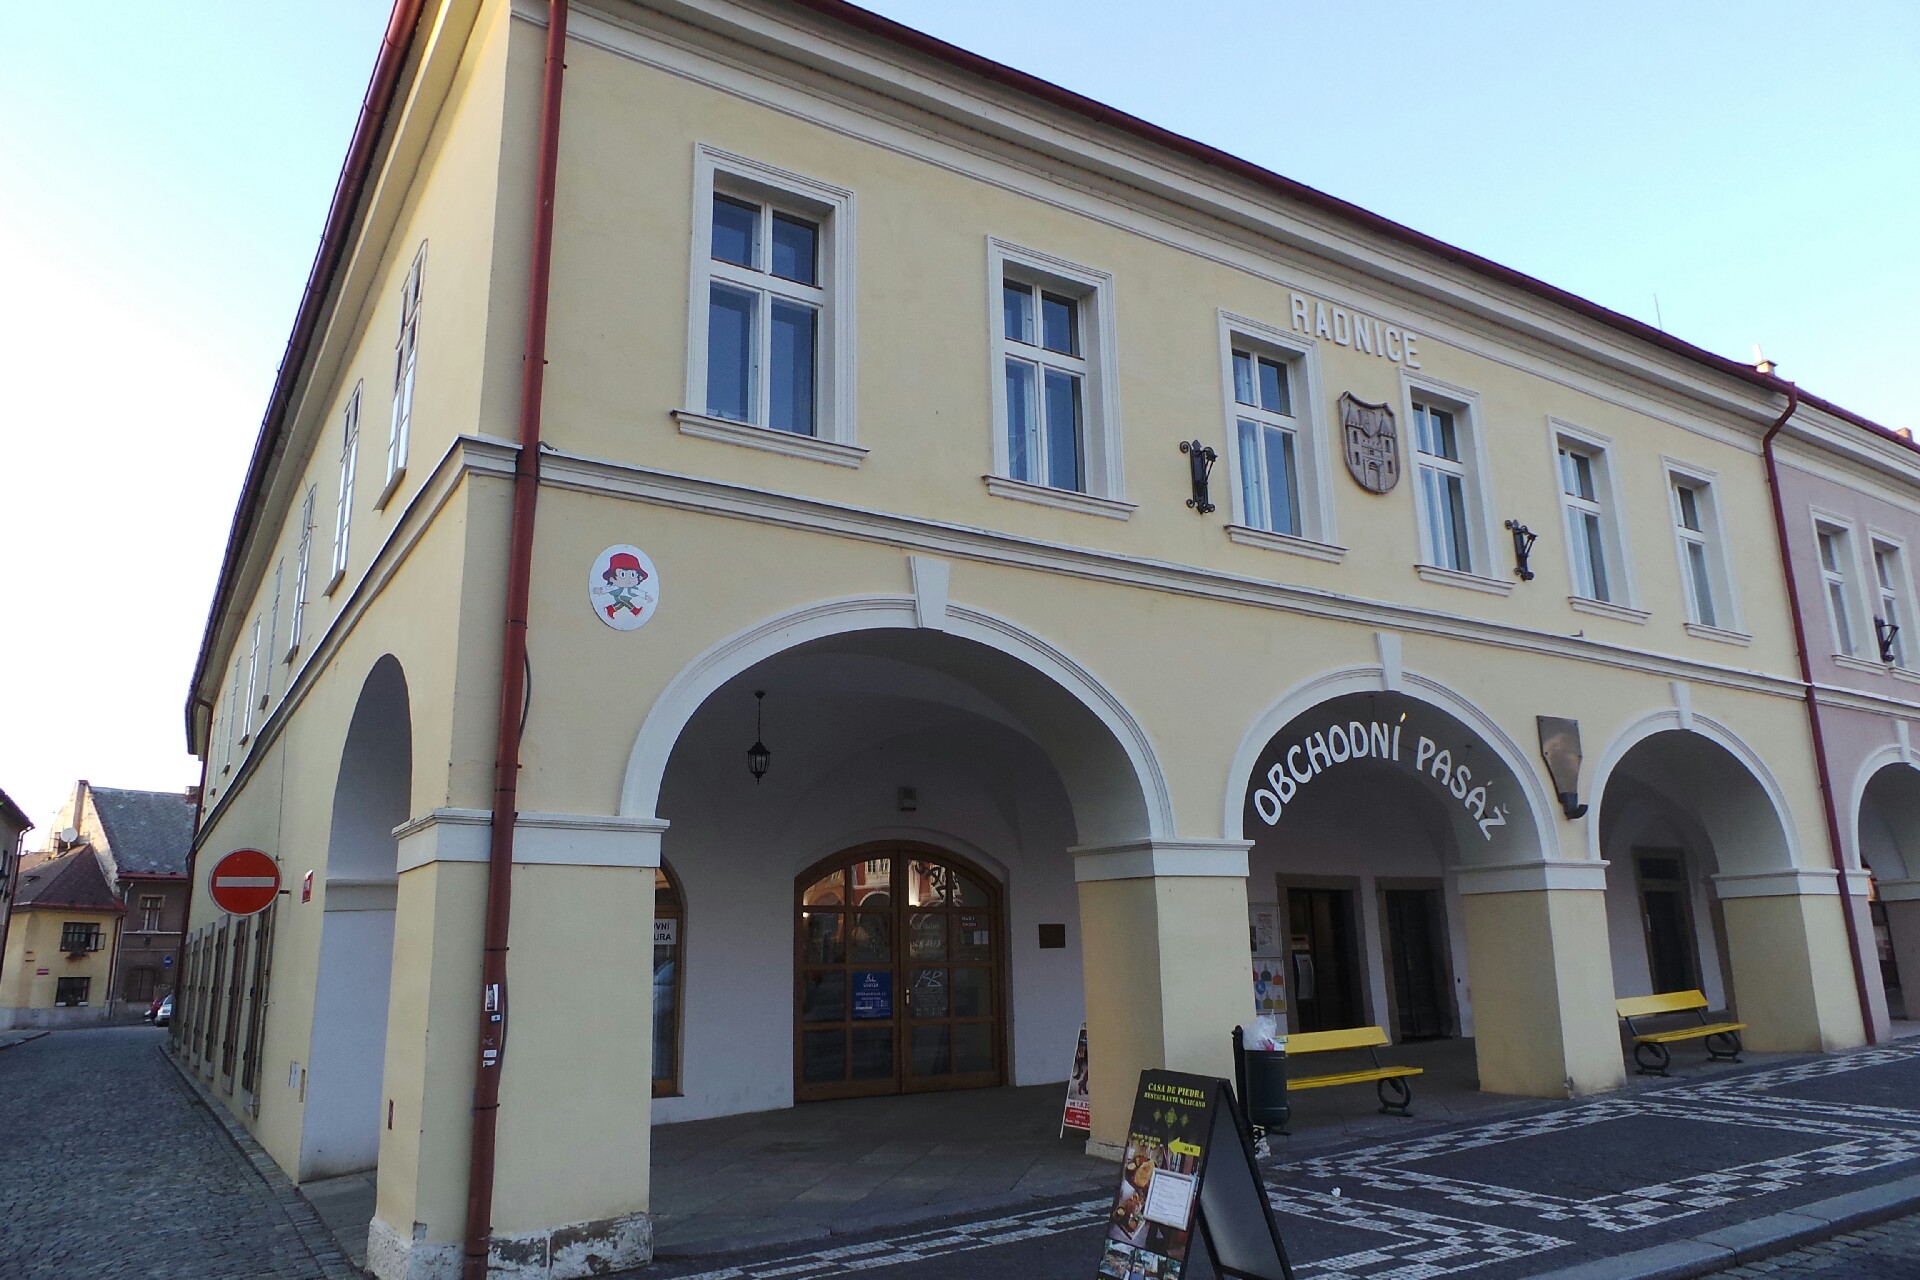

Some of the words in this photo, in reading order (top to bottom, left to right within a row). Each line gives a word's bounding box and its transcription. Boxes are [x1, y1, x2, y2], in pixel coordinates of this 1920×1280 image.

[1289, 293, 1421, 369] RADNICE
[1254, 711, 1408, 826] OBCHODNÍ
[1416, 735, 1510, 841] PASÁŽ
[1148, 1082, 1166, 1093] CASA
[1166, 1085, 1176, 1094] DE
[1177, 1087, 1205, 1099] PIEDRA
